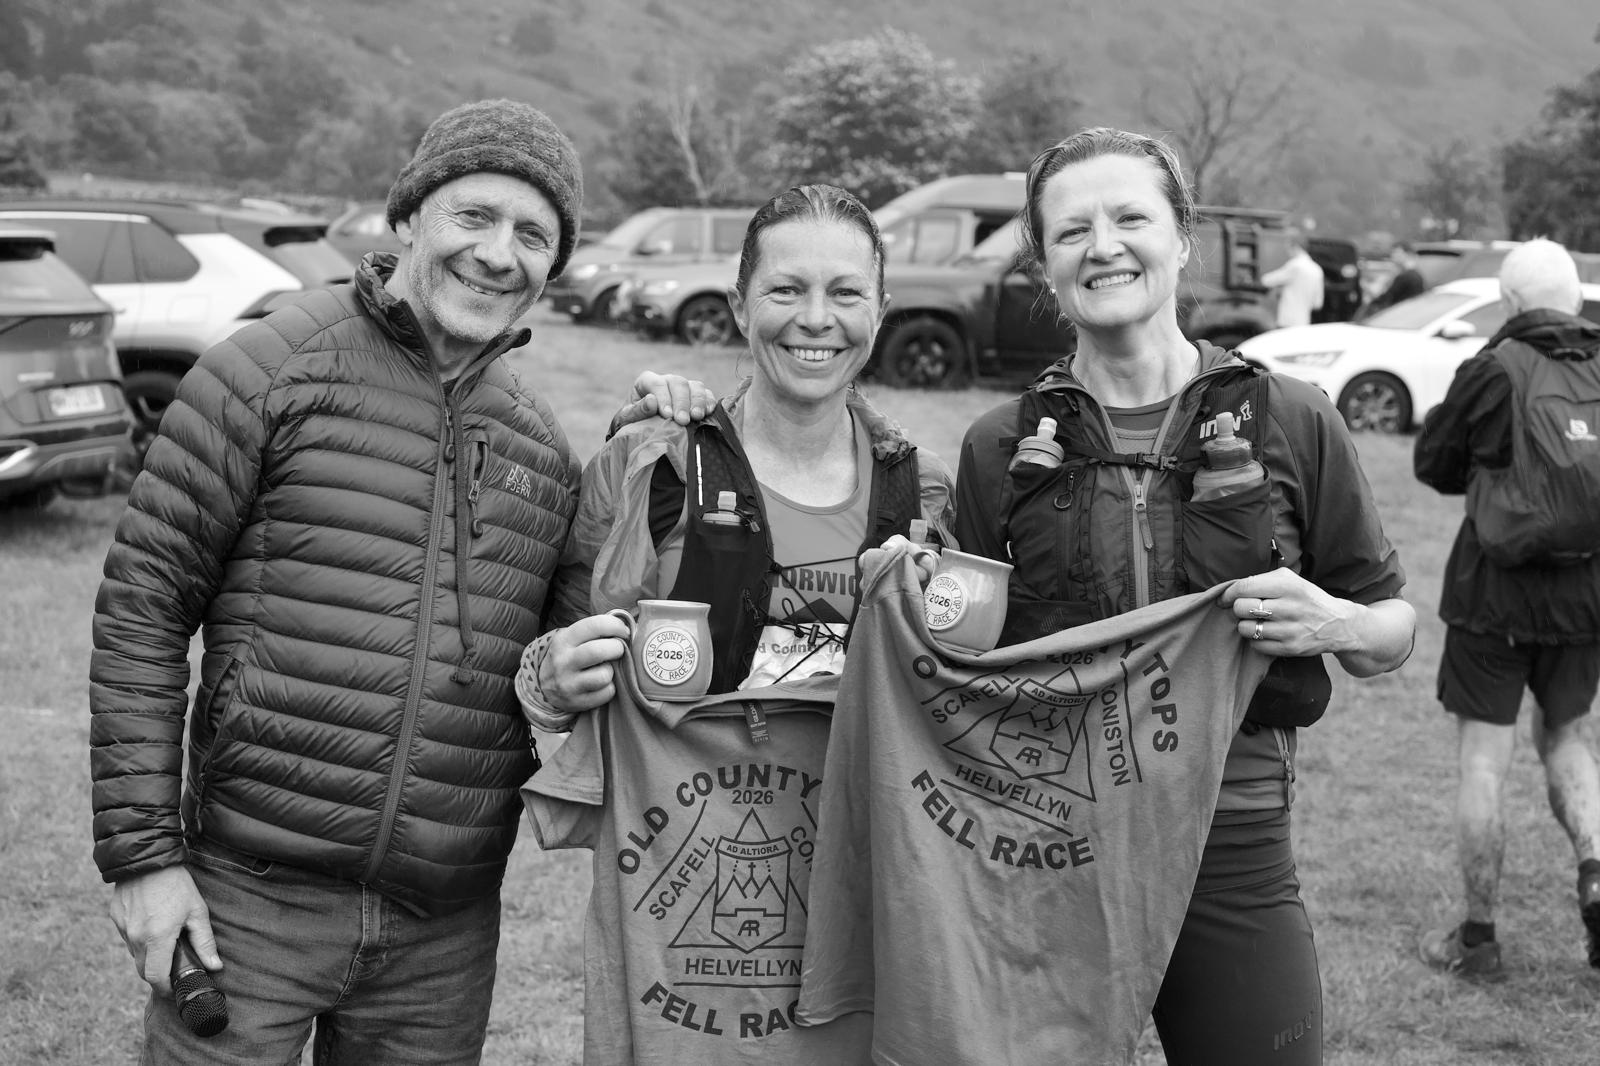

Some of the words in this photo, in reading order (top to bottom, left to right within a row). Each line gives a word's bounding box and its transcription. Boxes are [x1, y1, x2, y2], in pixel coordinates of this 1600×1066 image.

[929, 593, 951, 607] 2026
[933, 611, 952, 625] RACE
[647, 643, 658, 658] OLD
[656, 632, 686, 644] COUNTY
[685, 644, 695, 666] TOPS
[656, 649, 683, 659] 2026
[649, 660, 663, 678] FELL
[669, 665, 689, 680] RACE
[931, 674, 1021, 724] SCAFELL
[1031, 687, 1046, 698] AD
[1142, 652, 1179, 752] TOPS
[731, 789, 774, 805] 2026
[955, 764, 1072, 822] HELVELLYN
[617, 806, 670, 875] OLD
[676, 763, 822, 807] COUNTY
[911, 769, 976, 850] FELL
[990, 836, 1095, 870] RACE
[726, 844, 739, 853] AD
[740, 844, 780, 856] ALTIORA
[648, 836, 716, 921] SCAFELL
[684, 957, 803, 977] HELVELLYN
[640, 980, 724, 1036] FELL
